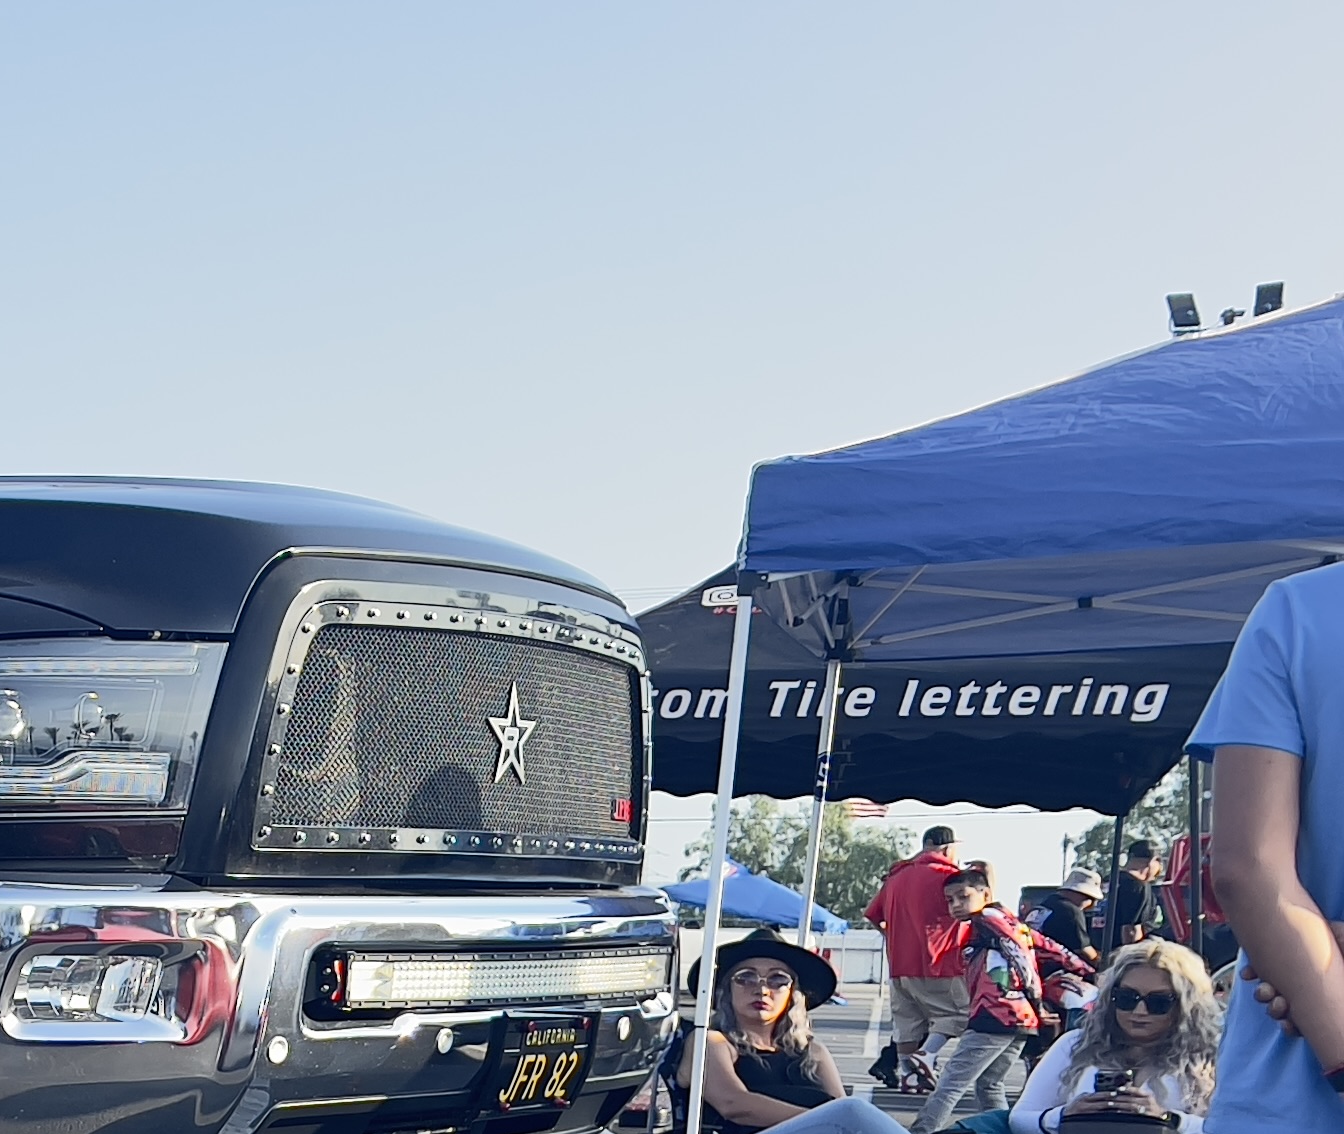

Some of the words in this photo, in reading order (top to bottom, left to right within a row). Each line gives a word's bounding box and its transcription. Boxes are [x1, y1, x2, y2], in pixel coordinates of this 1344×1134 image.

[898, 678, 1171, 722] lettering
[525, 1028, 576, 1046] CALIFORNIA
[499, 1053, 547, 1104] JFR
[544, 1051, 579, 1098] 82
